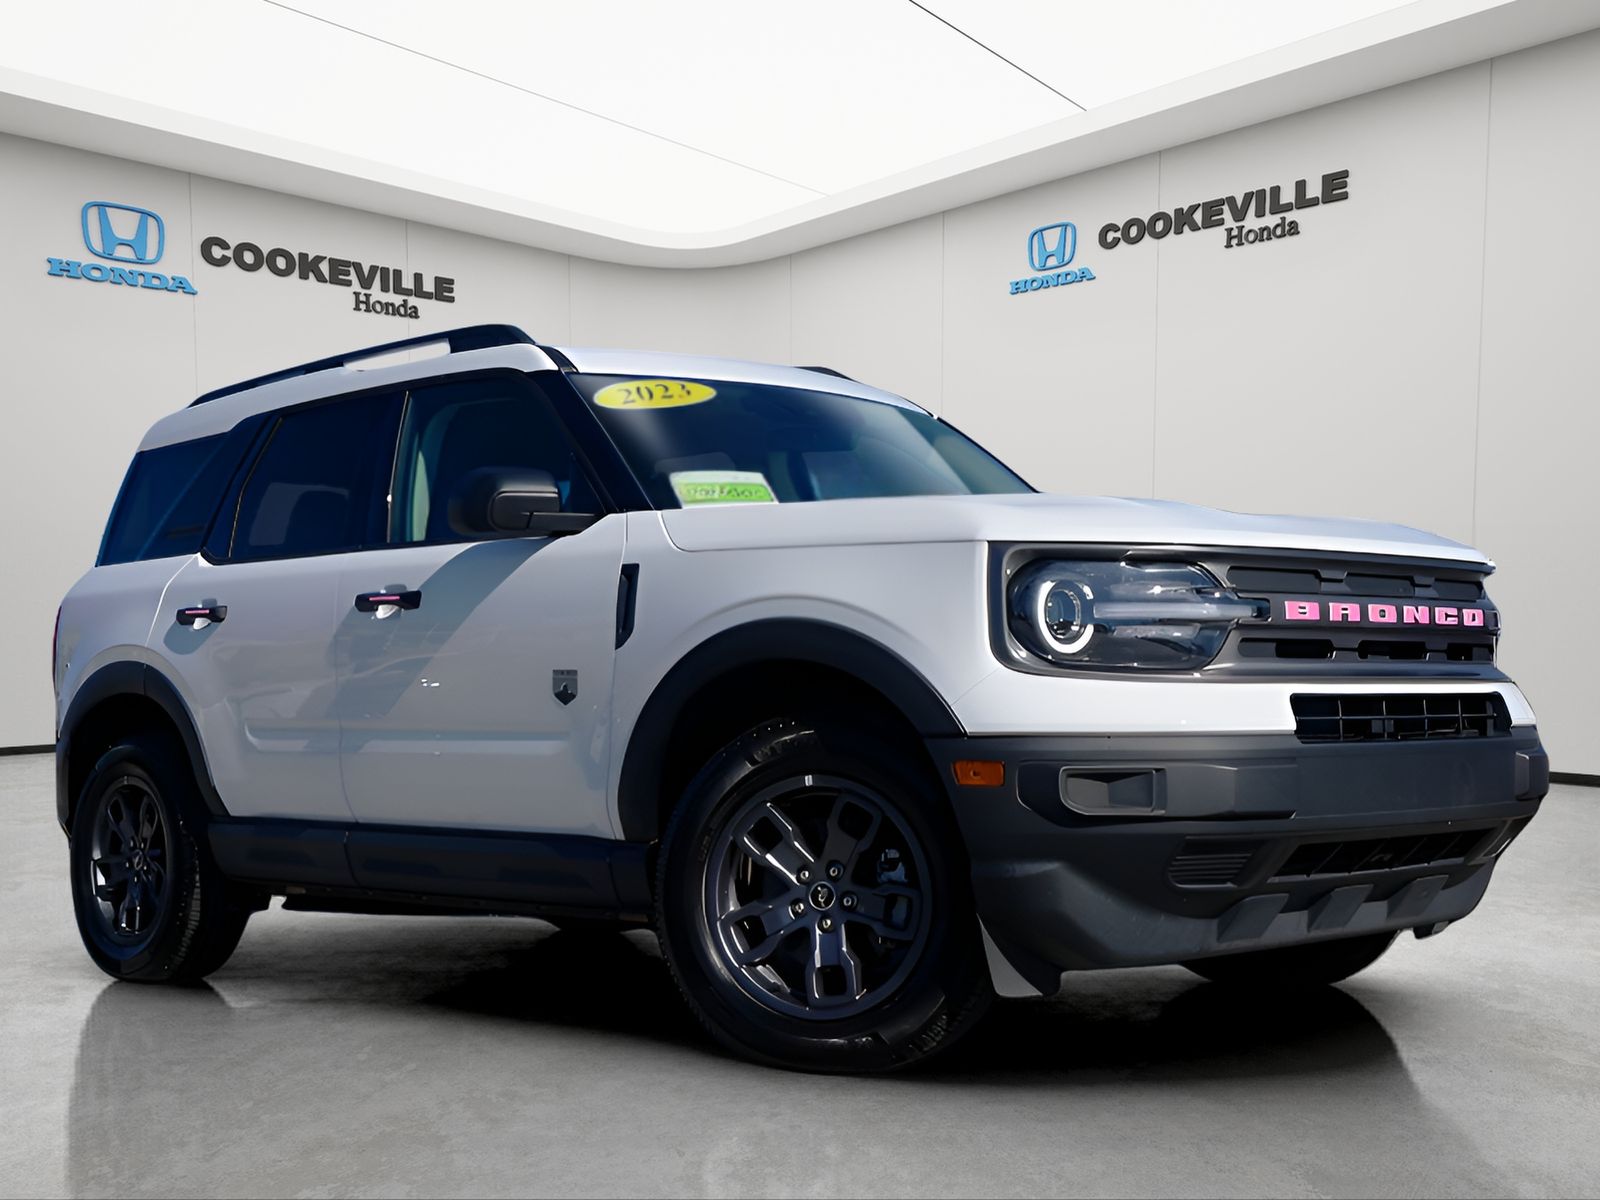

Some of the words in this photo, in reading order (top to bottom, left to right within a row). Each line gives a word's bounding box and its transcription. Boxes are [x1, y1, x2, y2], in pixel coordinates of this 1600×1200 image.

[1098, 169, 1349, 249] COOKEVILLE
[1224, 217, 1300, 248] Honda
[47, 257, 197, 295] HONDA
[200, 236, 455, 303] COOKEVILLE
[1009, 266, 1095, 295] HONDA
[352, 292, 420, 319] Honda
[620, 383, 691, 404] 2023
[1284, 600, 1484, 627] BRONCO
